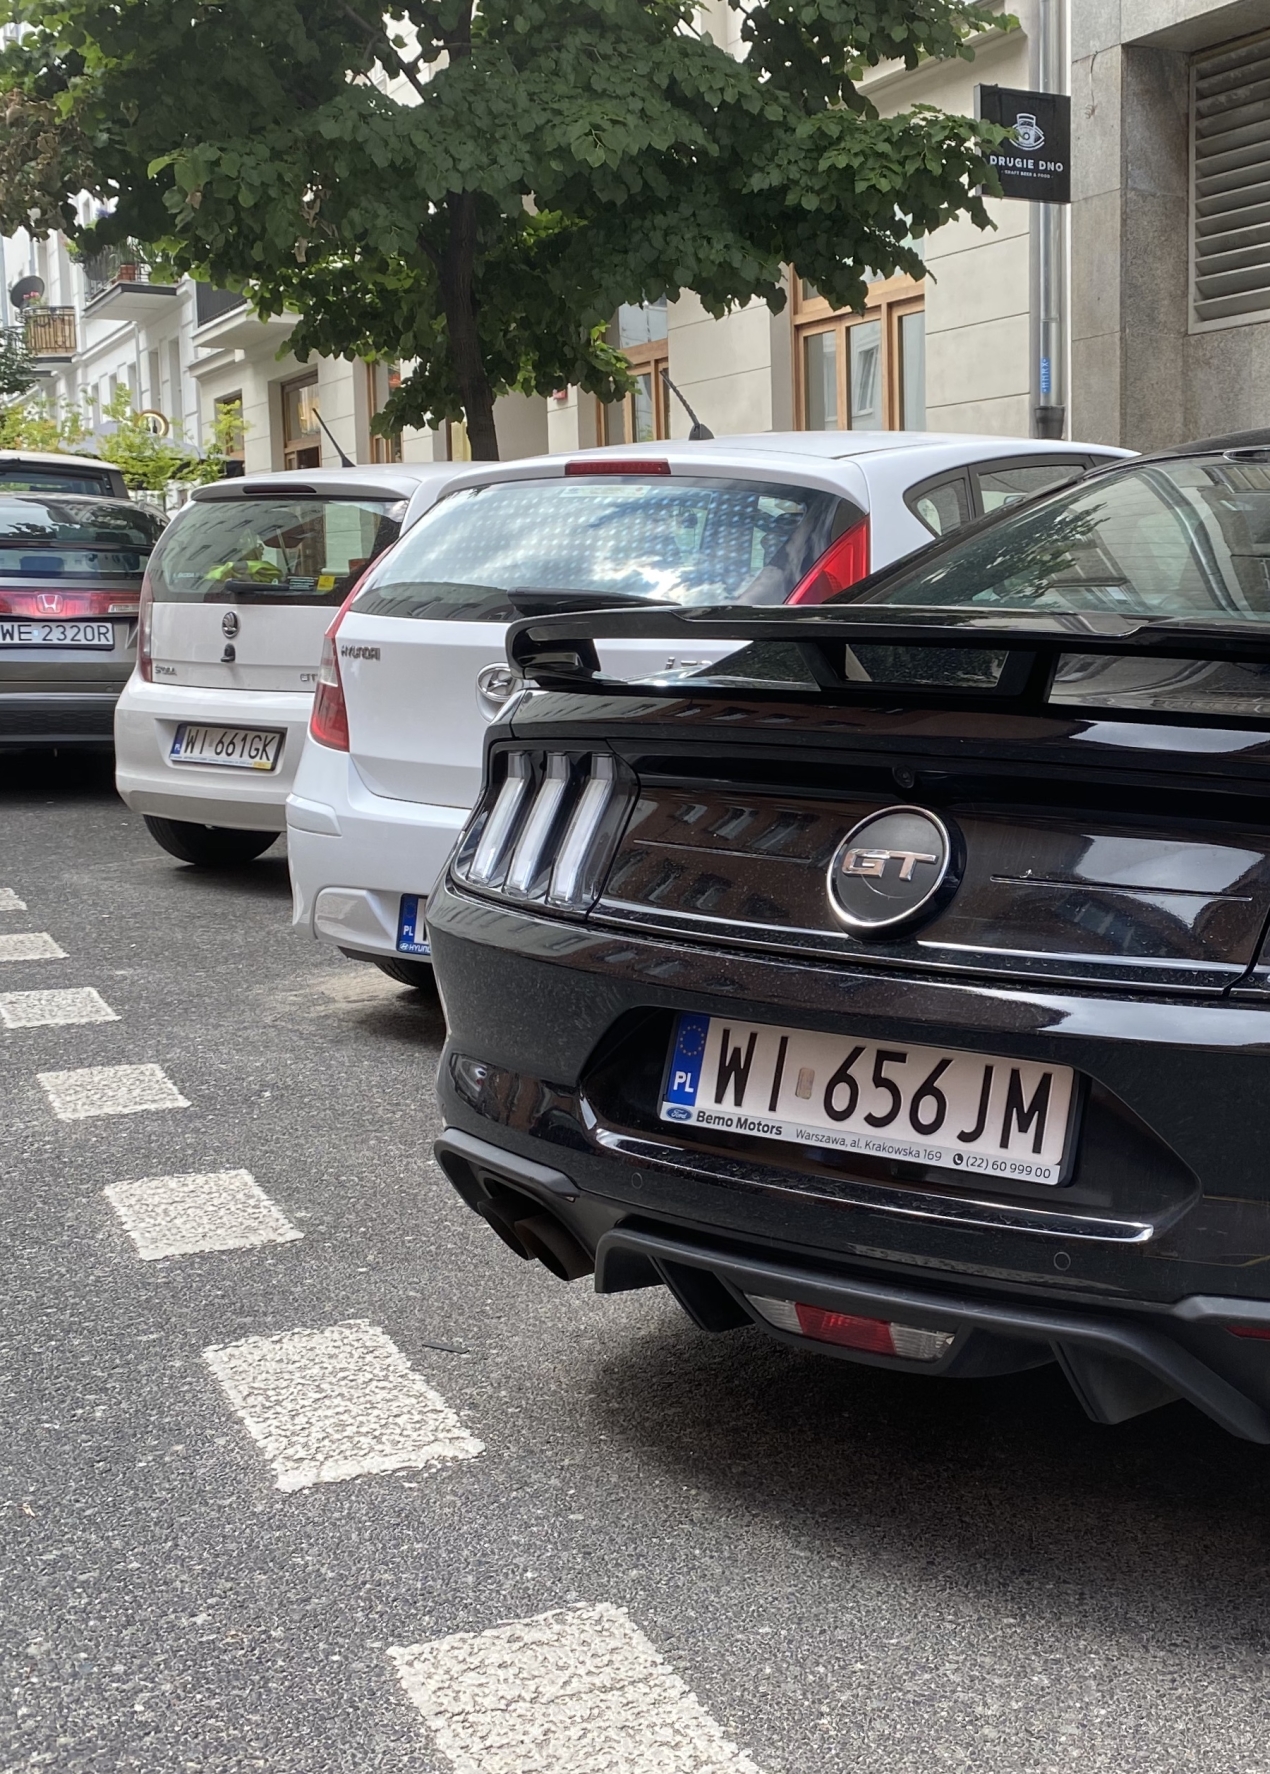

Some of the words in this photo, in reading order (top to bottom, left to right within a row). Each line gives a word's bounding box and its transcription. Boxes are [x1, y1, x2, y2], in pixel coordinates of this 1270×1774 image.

[990, 155, 1034, 169] DRUGIE
[1038, 160, 1063, 172] DNO
[0, 624, 33, 642] WE
[41, 624, 111, 643] 2320R
[341, 645, 381, 661] HYUNDAI
[184, 728, 208, 755] WI
[214, 730, 277, 761] 661GK
[842, 848, 938, 882] GT
[403, 924, 414, 937] PL
[673, 1070, 694, 1094] PL
[714, 1027, 789, 1112] WI
[823, 1044, 1053, 1154] 656JM
[696, 1110, 734, 1129] Bemo
[735, 1117, 783, 1136] Motors
[796, 1129, 848, 1148] Warszawa,
[850, 1134, 863, 1149] al.
[864, 1140, 921, 1159] Krakowska
[923, 1150, 942, 1162] 169
[966, 1155, 989, 1170] (22)
[991, 1159, 1007, 1172] 60
[1009, 1163, 1033, 1176] 999
[1034, 1167, 1051, 1179] 00
